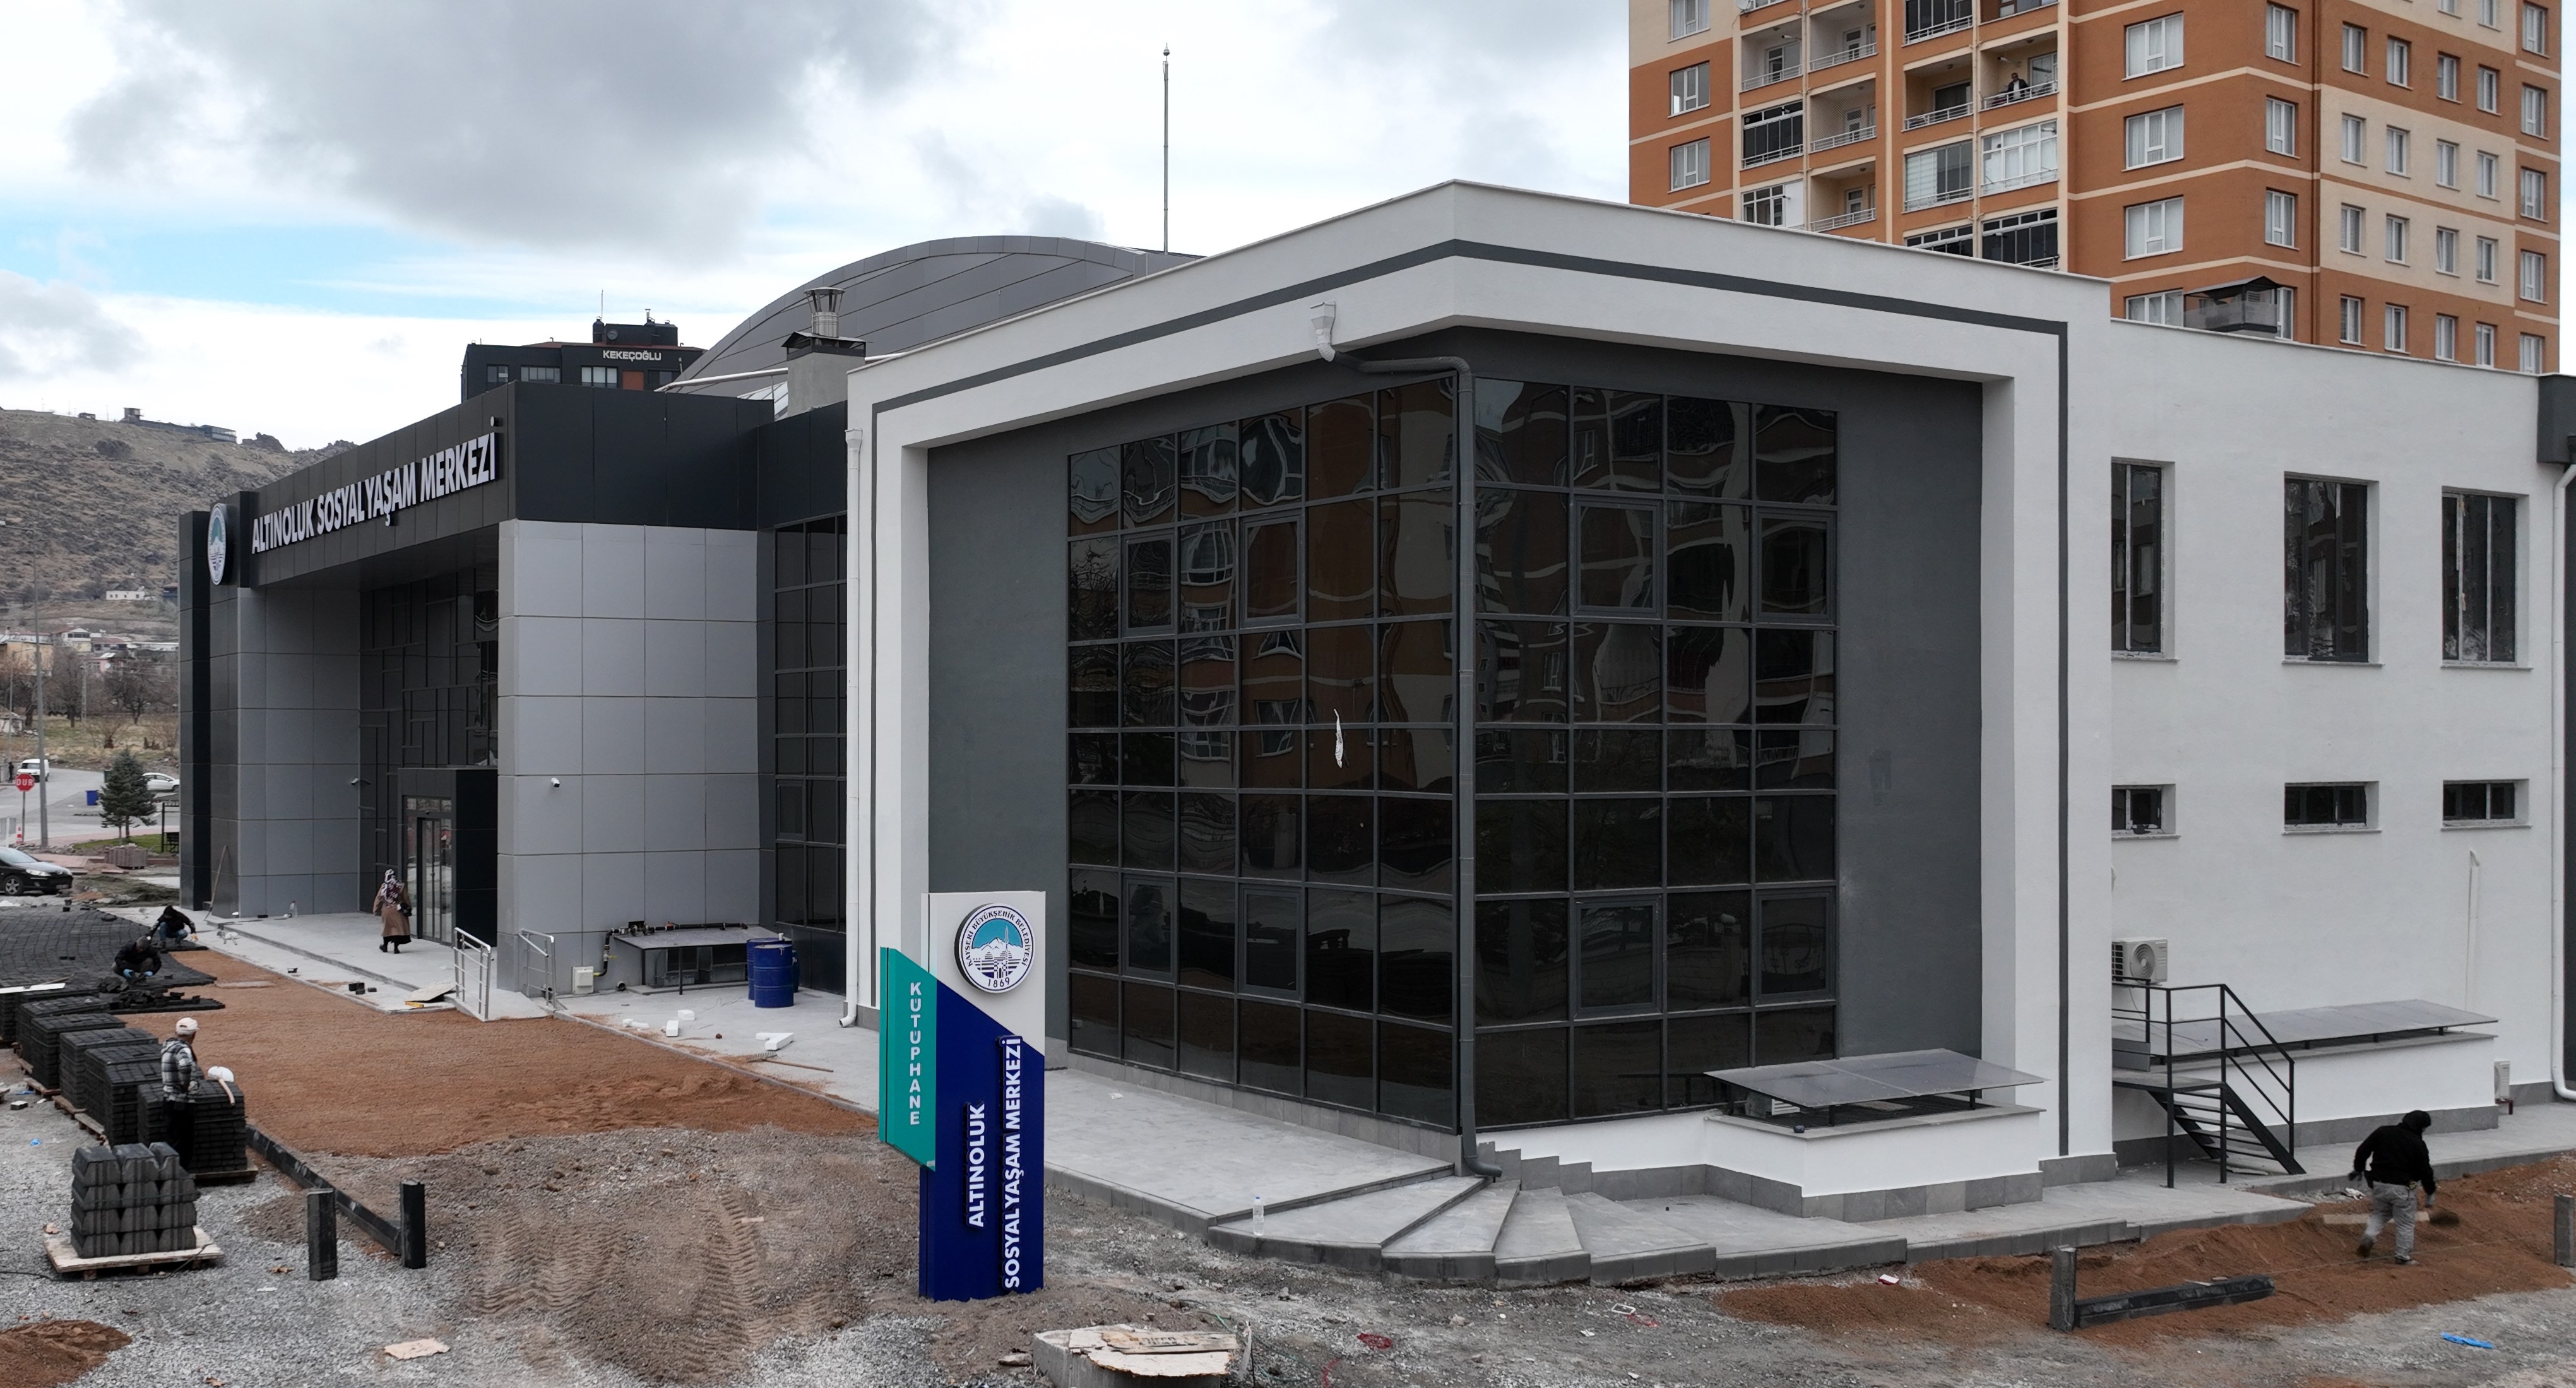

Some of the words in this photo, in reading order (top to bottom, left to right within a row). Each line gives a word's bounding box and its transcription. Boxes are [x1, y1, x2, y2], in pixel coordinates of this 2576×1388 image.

[603, 350, 662, 362] KEKEÇOĞLU
[252, 499, 315, 554] ALTINOLUK
[317, 482, 365, 535] SOSYAL
[364, 461, 417, 527] YAŞAM
[420, 416, 496, 502] MERKEZİ
[16, 778, 34, 786] DUR
[965, 930, 974, 967] KAYSERİ
[972, 910, 1016, 930] BÜYÜKŞEHİR
[1015, 918, 1030, 967] BELEDİYESİ
[988, 977, 1010, 988] 1869
[1001, 1038, 1021, 1130] MERKEZİ
[969, 1103, 985, 1227] ALTINOLUK
[1004, 1134, 1024, 1209] YAŞAM
[1004, 1208, 1020, 1288] SOSYAL
